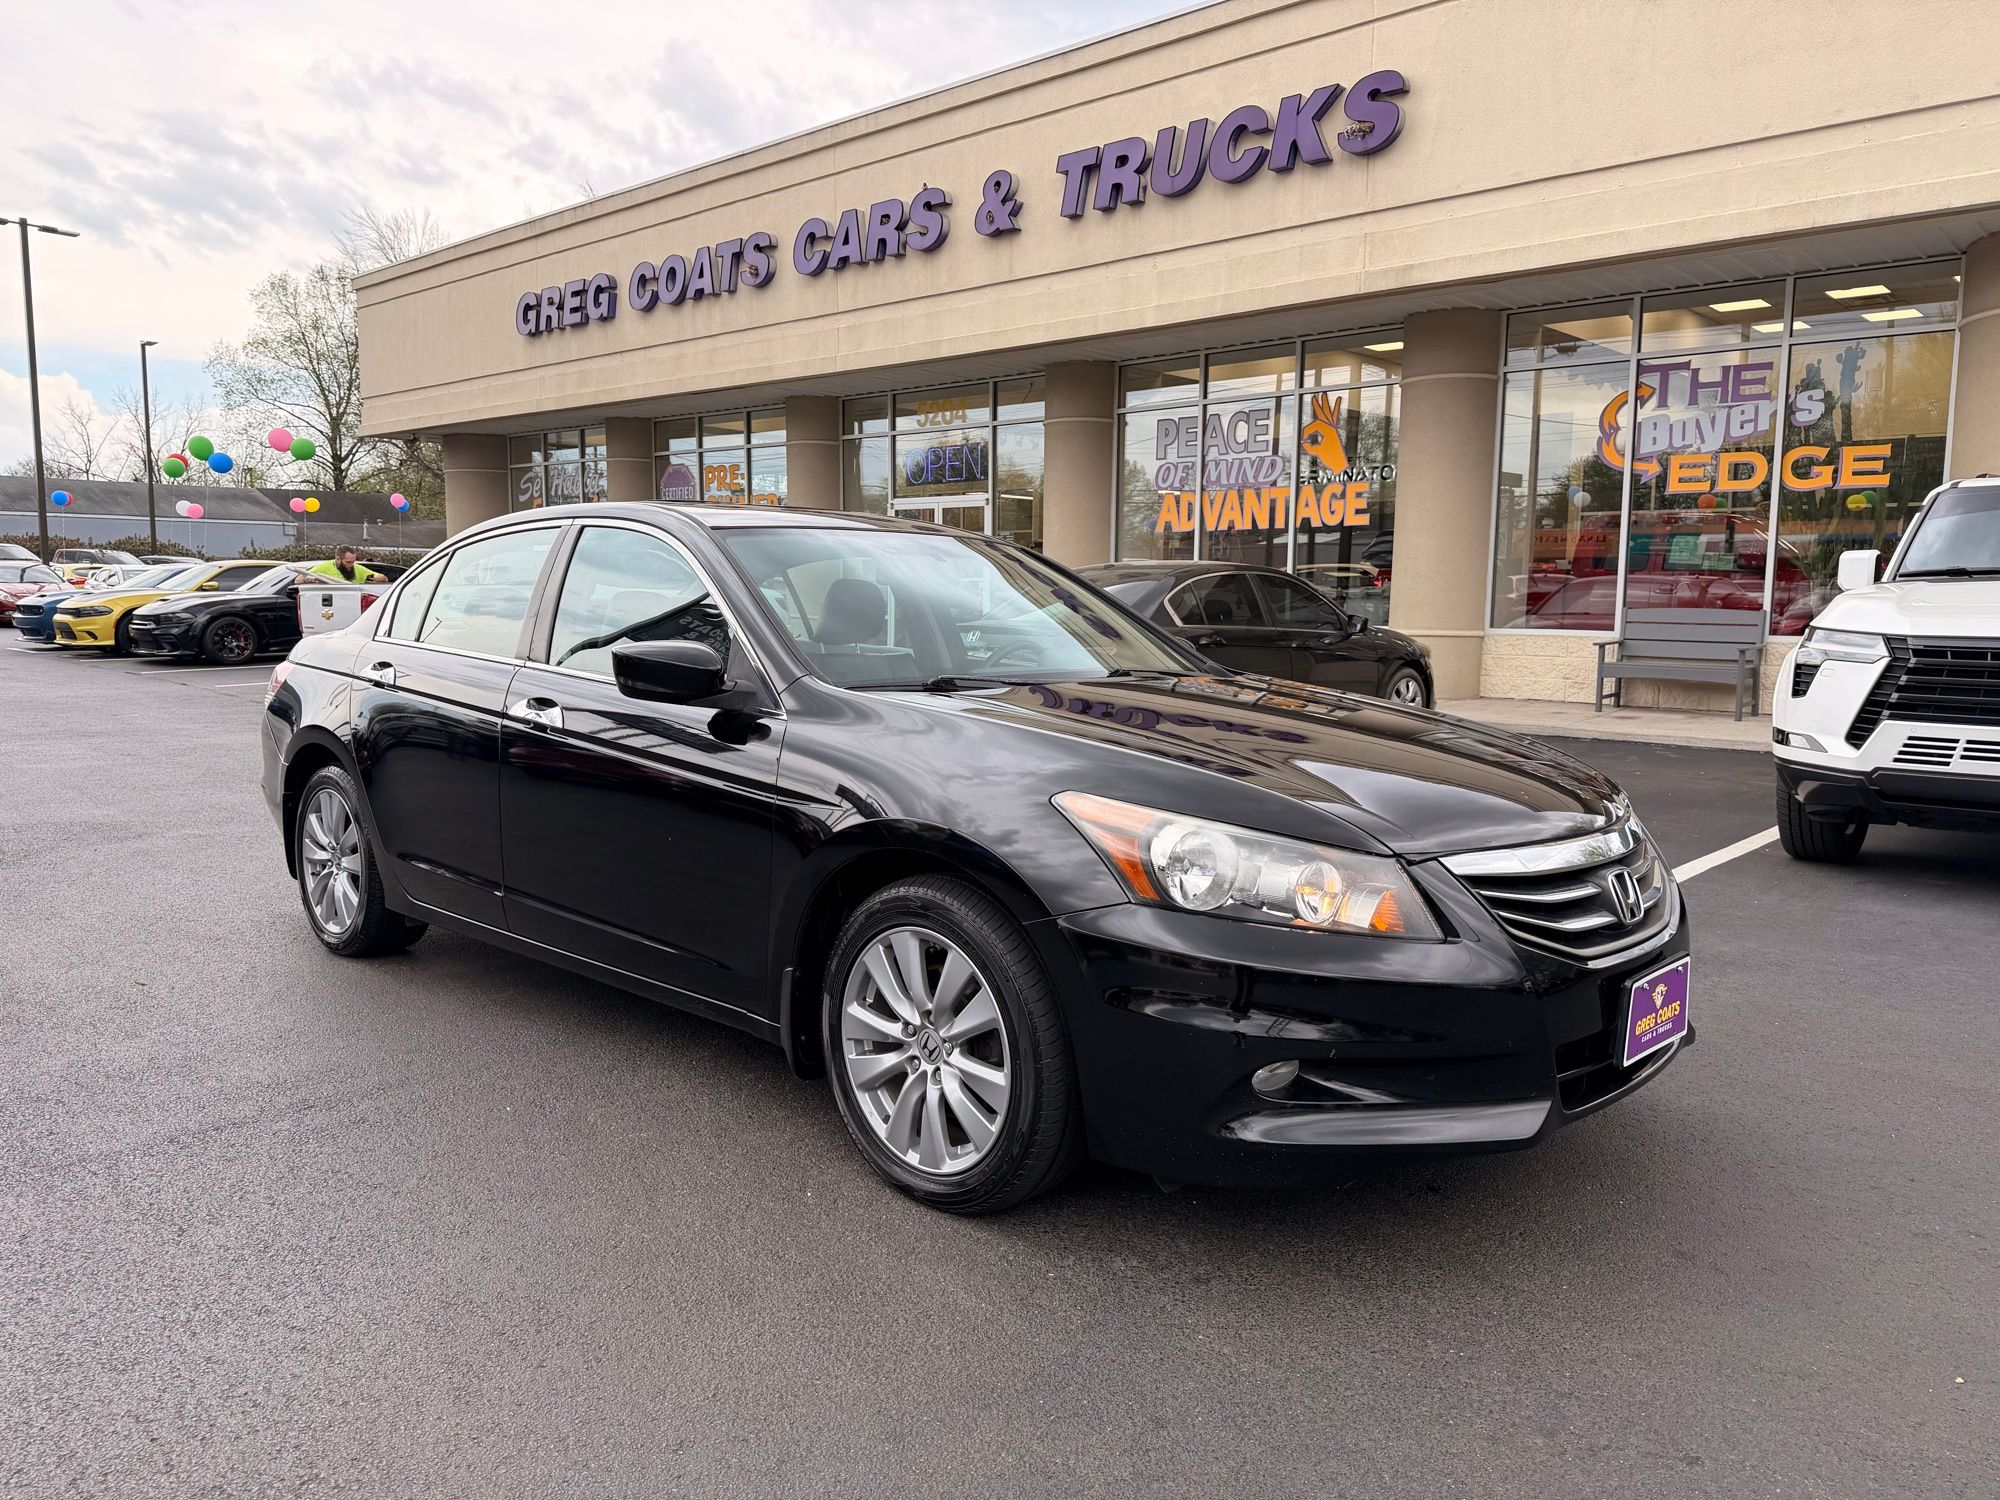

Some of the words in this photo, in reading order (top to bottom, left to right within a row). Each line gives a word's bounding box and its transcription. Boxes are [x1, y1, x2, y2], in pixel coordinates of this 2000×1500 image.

[515, 272, 618, 337] GREG
[628, 231, 778, 313] COATS
[792, 186, 952, 277] CARS
[974, 168, 1023, 238] &
[1055, 69, 1411, 220] TRUCKS
[1638, 359, 1775, 411] THE
[915, 399, 967, 428] 5204
[1155, 408, 1270, 460] PEACE
[518, 470, 542, 502] Se
[551, 462, 601, 496] Habla
[703, 463, 745, 493] PRE-
[906, 443, 982, 485] OPEN
[1155, 461, 1194, 490] OF
[1203, 455, 1284, 489] MIND
[1664, 443, 1893, 495] EDGE
[661, 486, 694, 500] CERTIFIED
[1154, 481, 1371, 534] ADVANTAGE
[1635, 1012, 1656, 1036] GREG
[1657, 1000, 1681, 1024] COATS
[1641, 1031, 1652, 1043] CARS
[1657, 1022, 1673, 1035] TRUCKS
